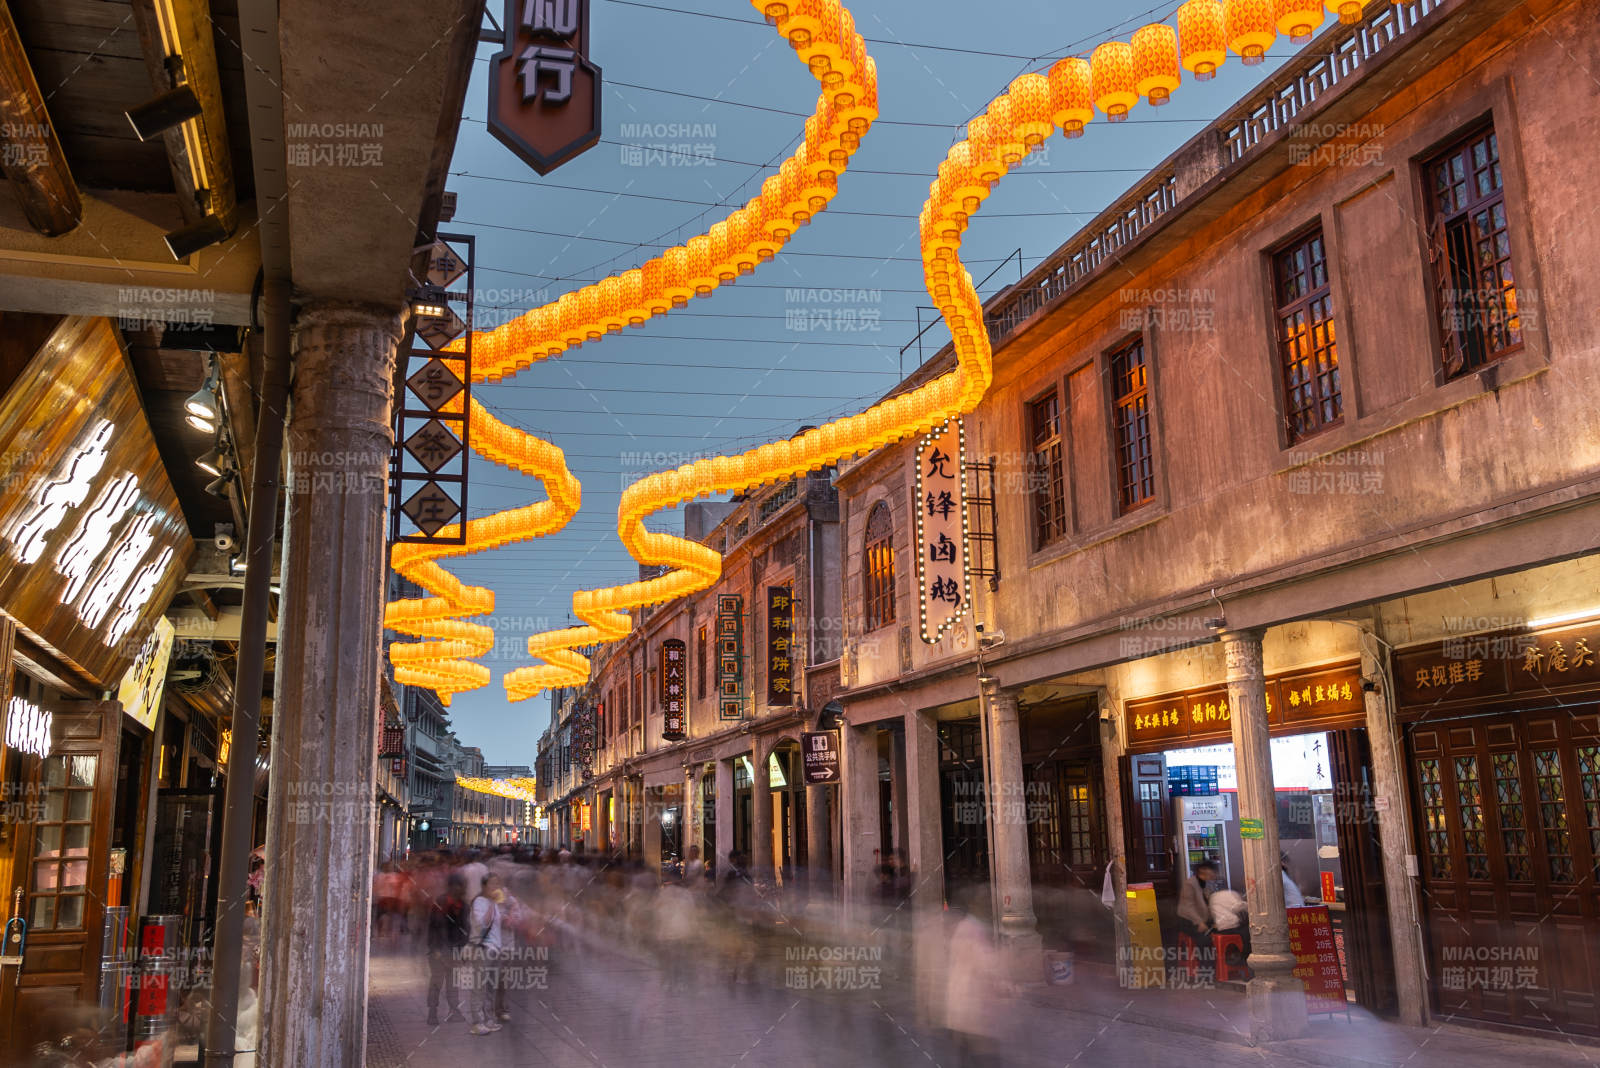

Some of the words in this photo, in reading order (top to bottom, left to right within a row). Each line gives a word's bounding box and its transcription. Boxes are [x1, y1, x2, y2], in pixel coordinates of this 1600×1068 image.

[926, 447, 962, 608] 允锋卤鹅
[1416, 659, 1484, 689] 央视推荐
[1289, 681, 1353, 707] 梅州盐焗鸡
[1319, 952, 1336, 963] 20元
[1321, 965, 1338, 976] 20元
